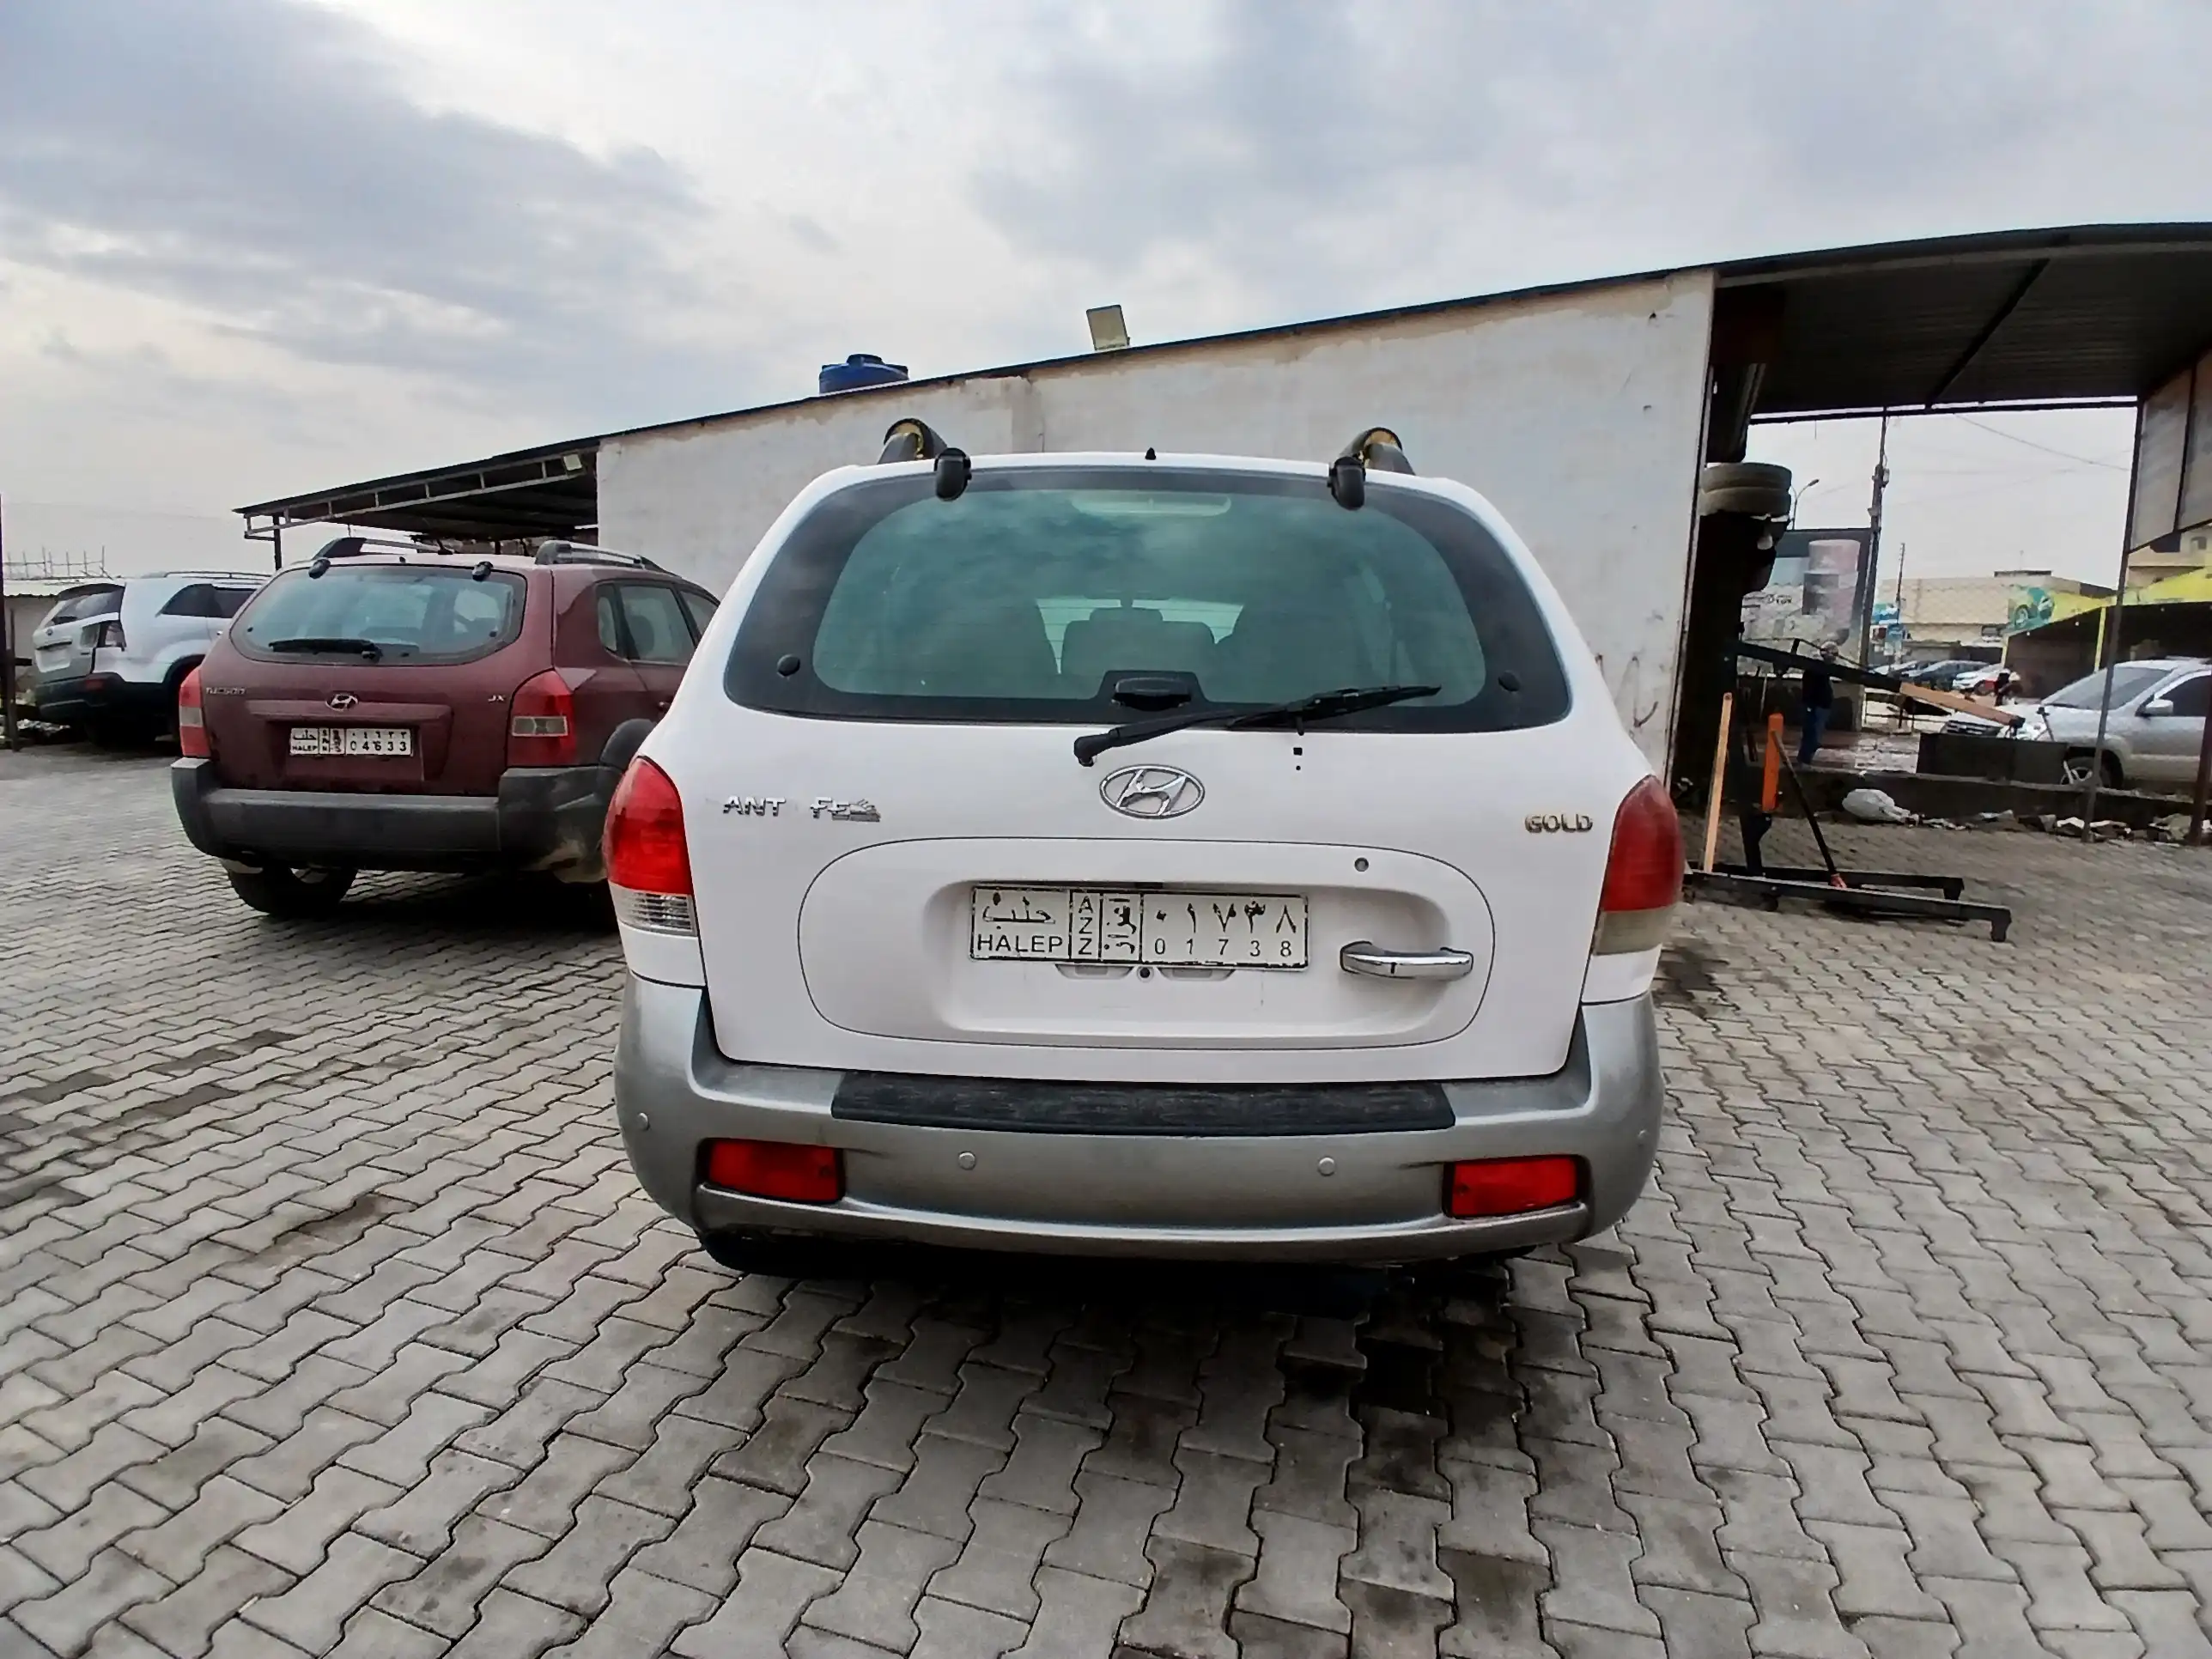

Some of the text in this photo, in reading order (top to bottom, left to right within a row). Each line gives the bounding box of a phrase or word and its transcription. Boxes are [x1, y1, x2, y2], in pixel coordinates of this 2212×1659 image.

[349, 740, 407, 751] 04633
[1524, 812, 1594, 834] GOLD
[981, 896, 1056, 930] حلب
[977, 933, 1063, 952] HALEP
[1154, 938, 1292, 957] 01738
